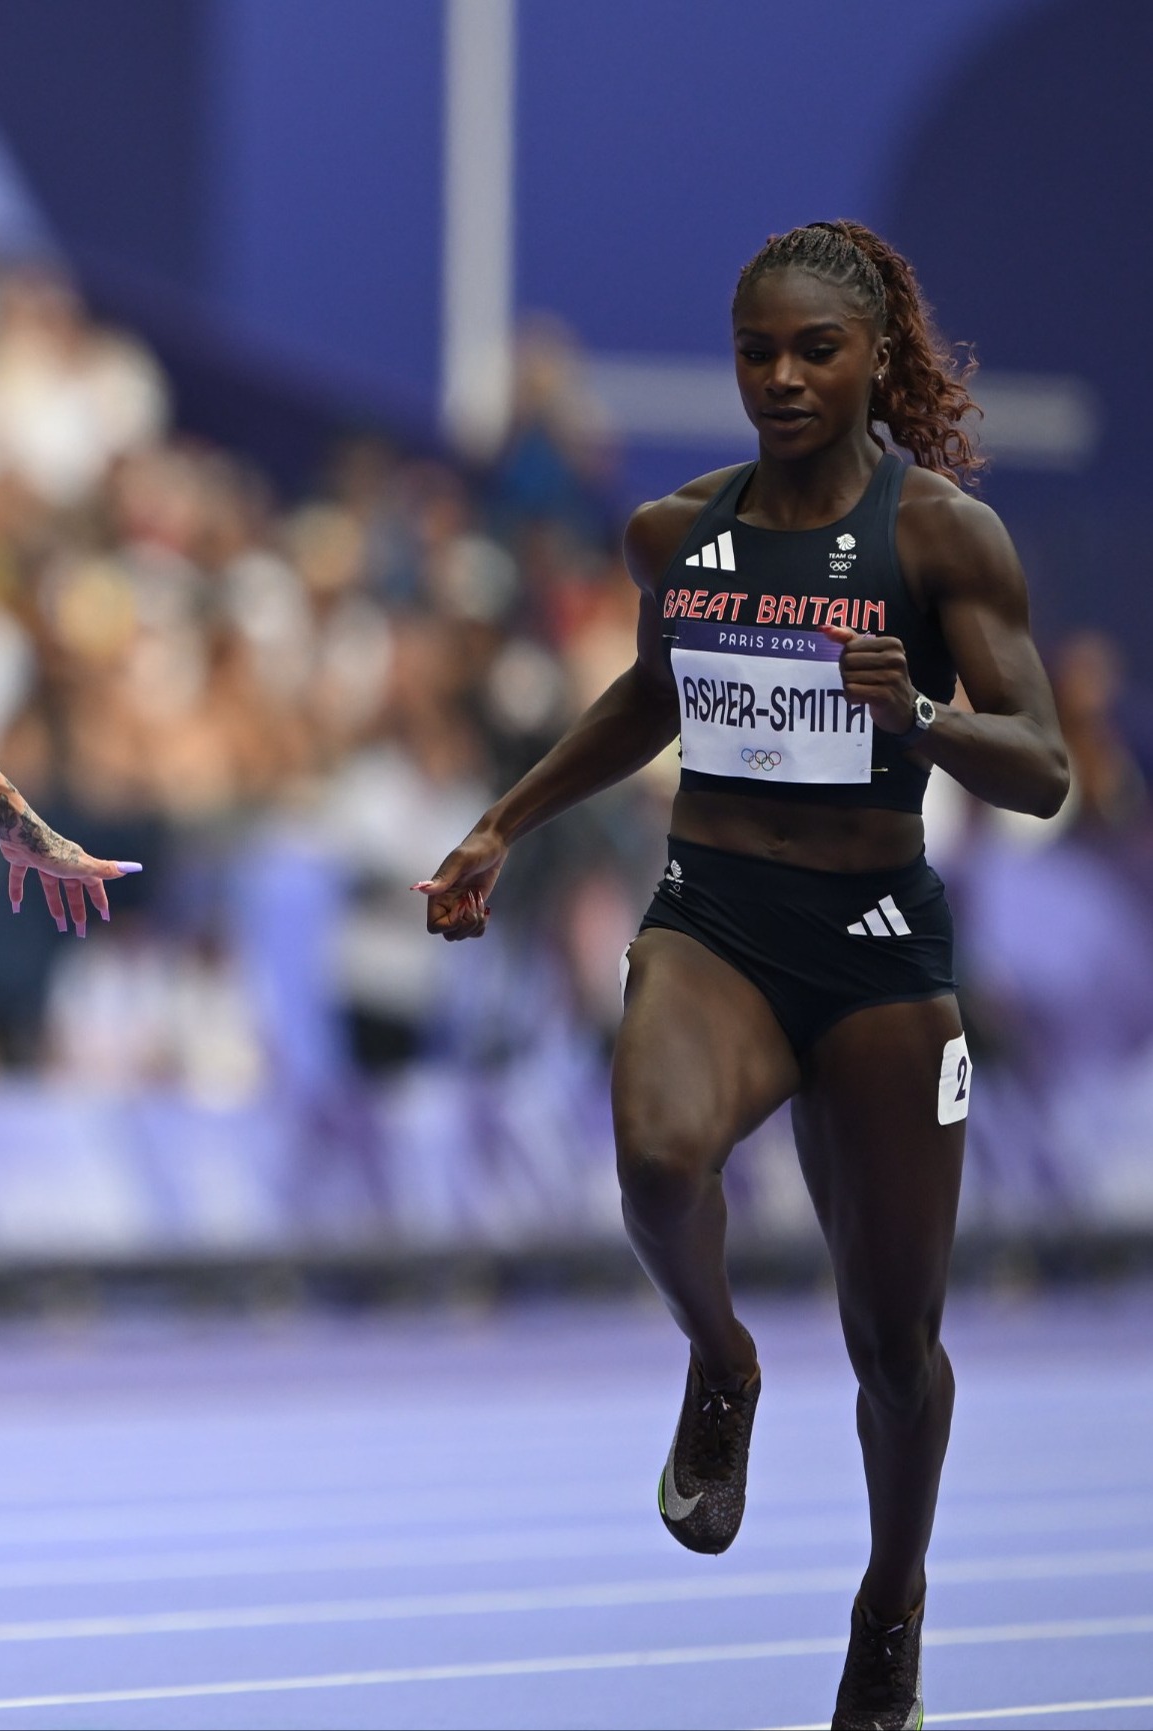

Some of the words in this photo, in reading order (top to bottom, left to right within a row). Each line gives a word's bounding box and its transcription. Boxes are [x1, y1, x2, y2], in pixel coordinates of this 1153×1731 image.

[663, 588, 748, 621] GREAT
[756, 594, 885, 631] BRITAIN
[771, 637, 817, 652] 2024
[682, 676, 866, 734] ASHER-SMITH
[954, 1056, 968, 1103] 2
